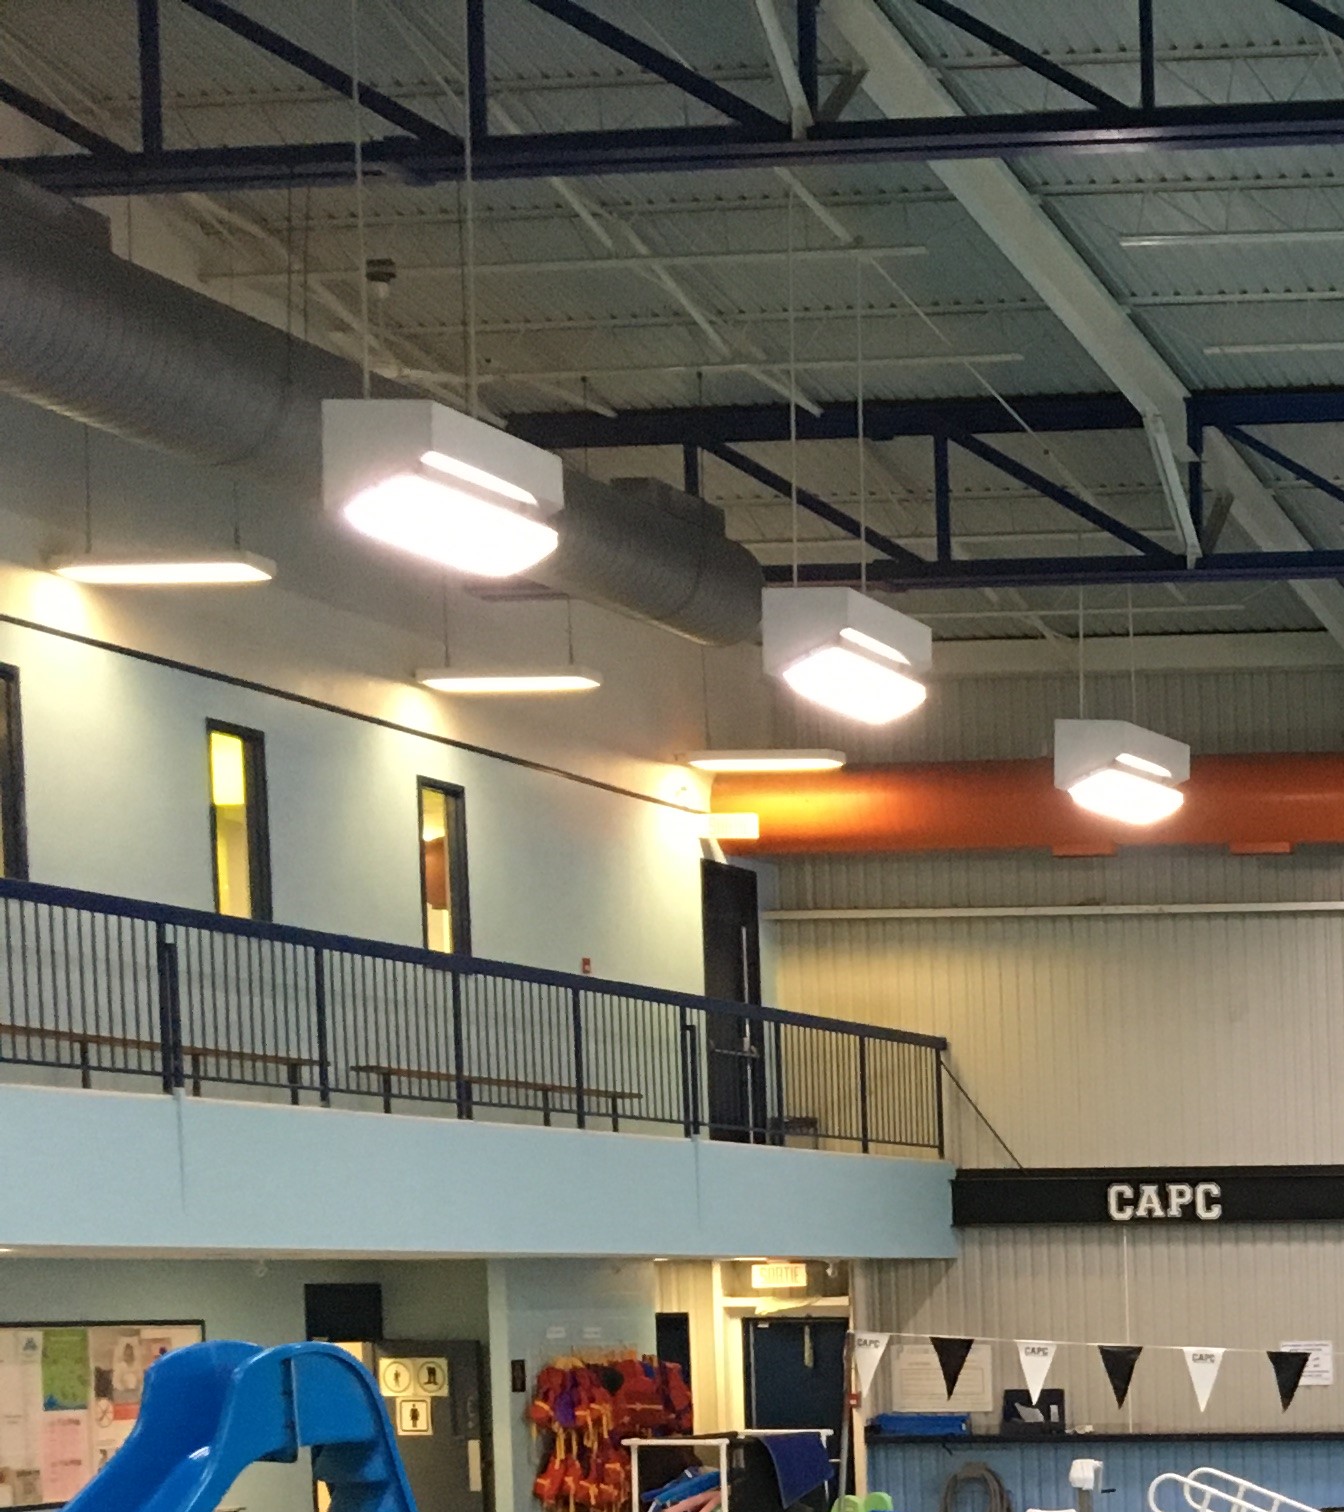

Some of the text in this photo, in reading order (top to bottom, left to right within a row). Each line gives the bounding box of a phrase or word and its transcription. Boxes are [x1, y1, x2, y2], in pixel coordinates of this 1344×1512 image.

[1107, 1181, 1222, 1220] CAPC
[1024, 1346, 1048, 1356] CAPC
[1192, 1353, 1215, 1363] CAPC
